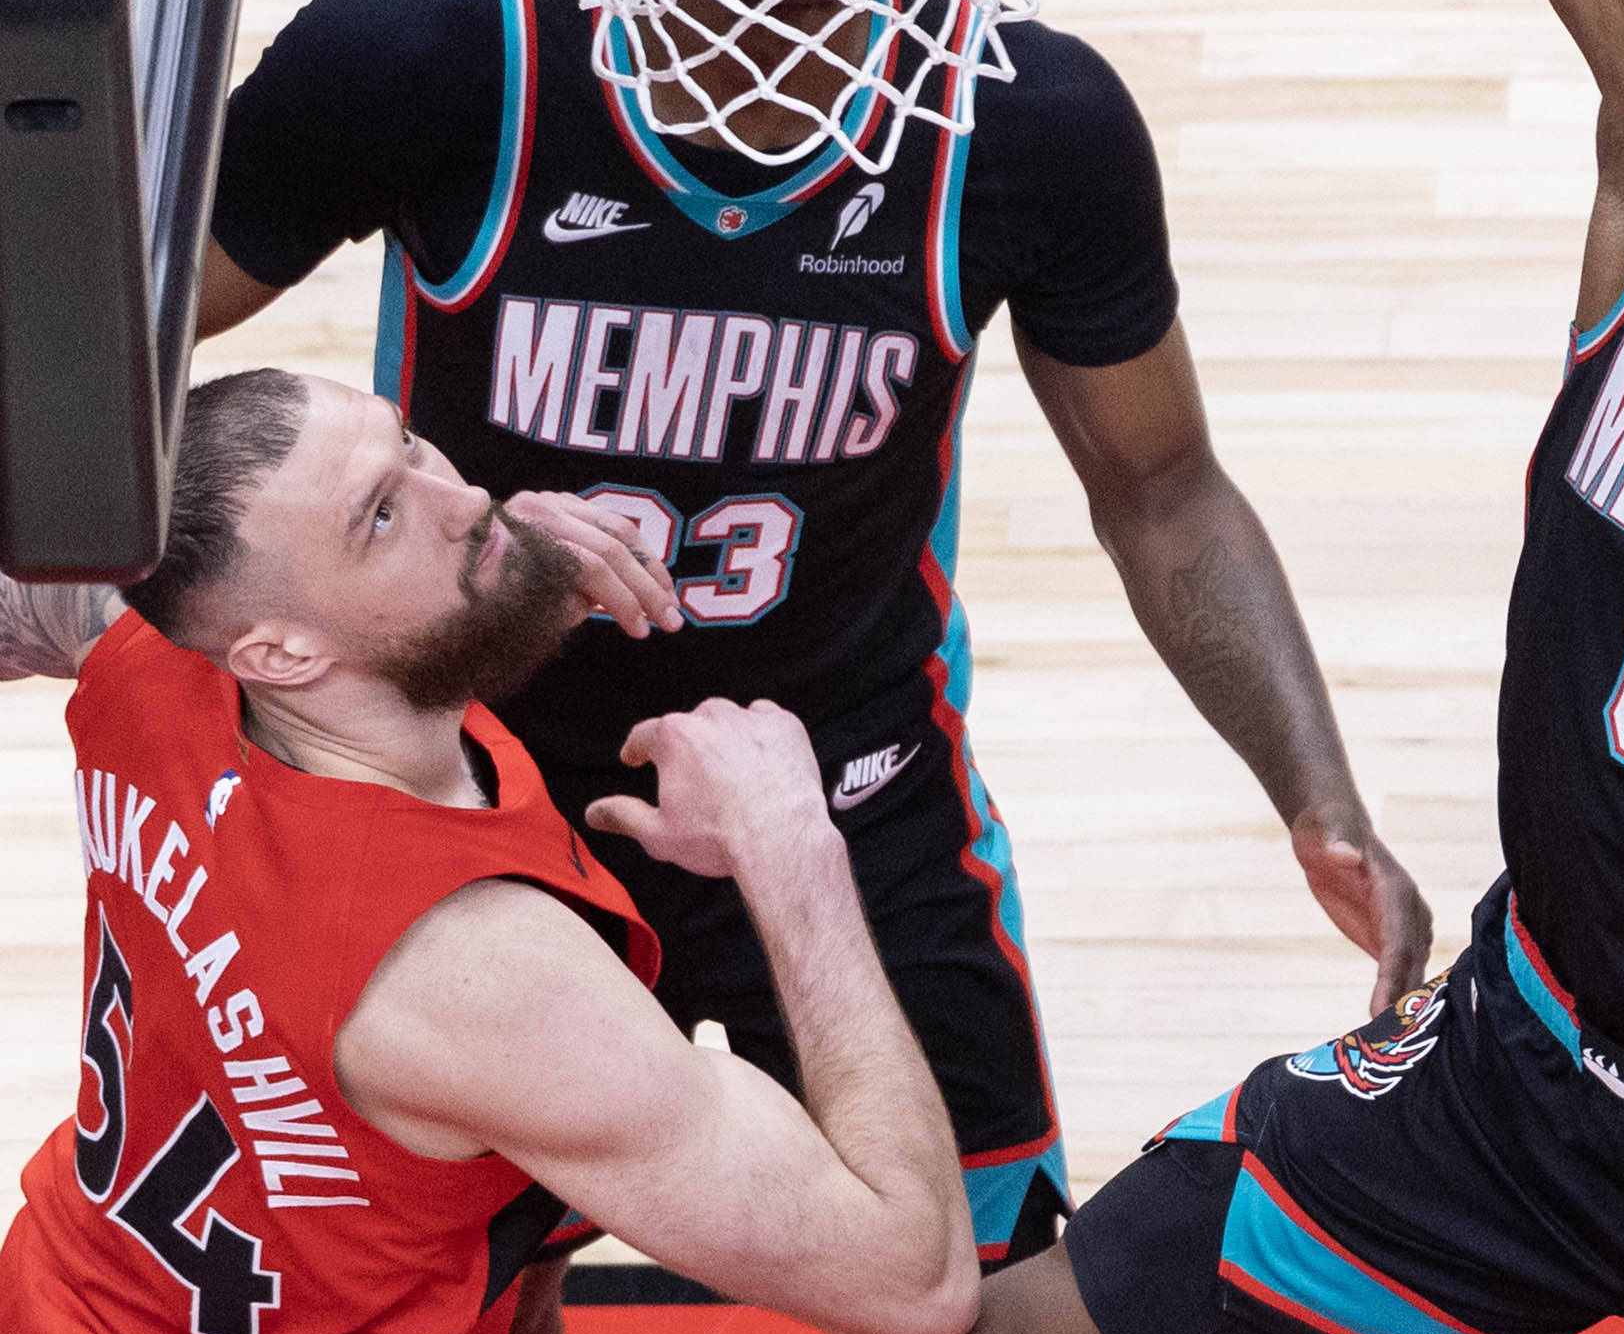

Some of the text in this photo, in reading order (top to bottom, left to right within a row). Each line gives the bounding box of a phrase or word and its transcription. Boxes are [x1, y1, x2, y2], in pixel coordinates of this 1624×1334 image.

[561, 192, 630, 230] NIKE
[800, 254, 905, 275] Robinhood
[489, 294, 920, 464] MEMPHIS
[842, 744, 901, 794] NIKE
